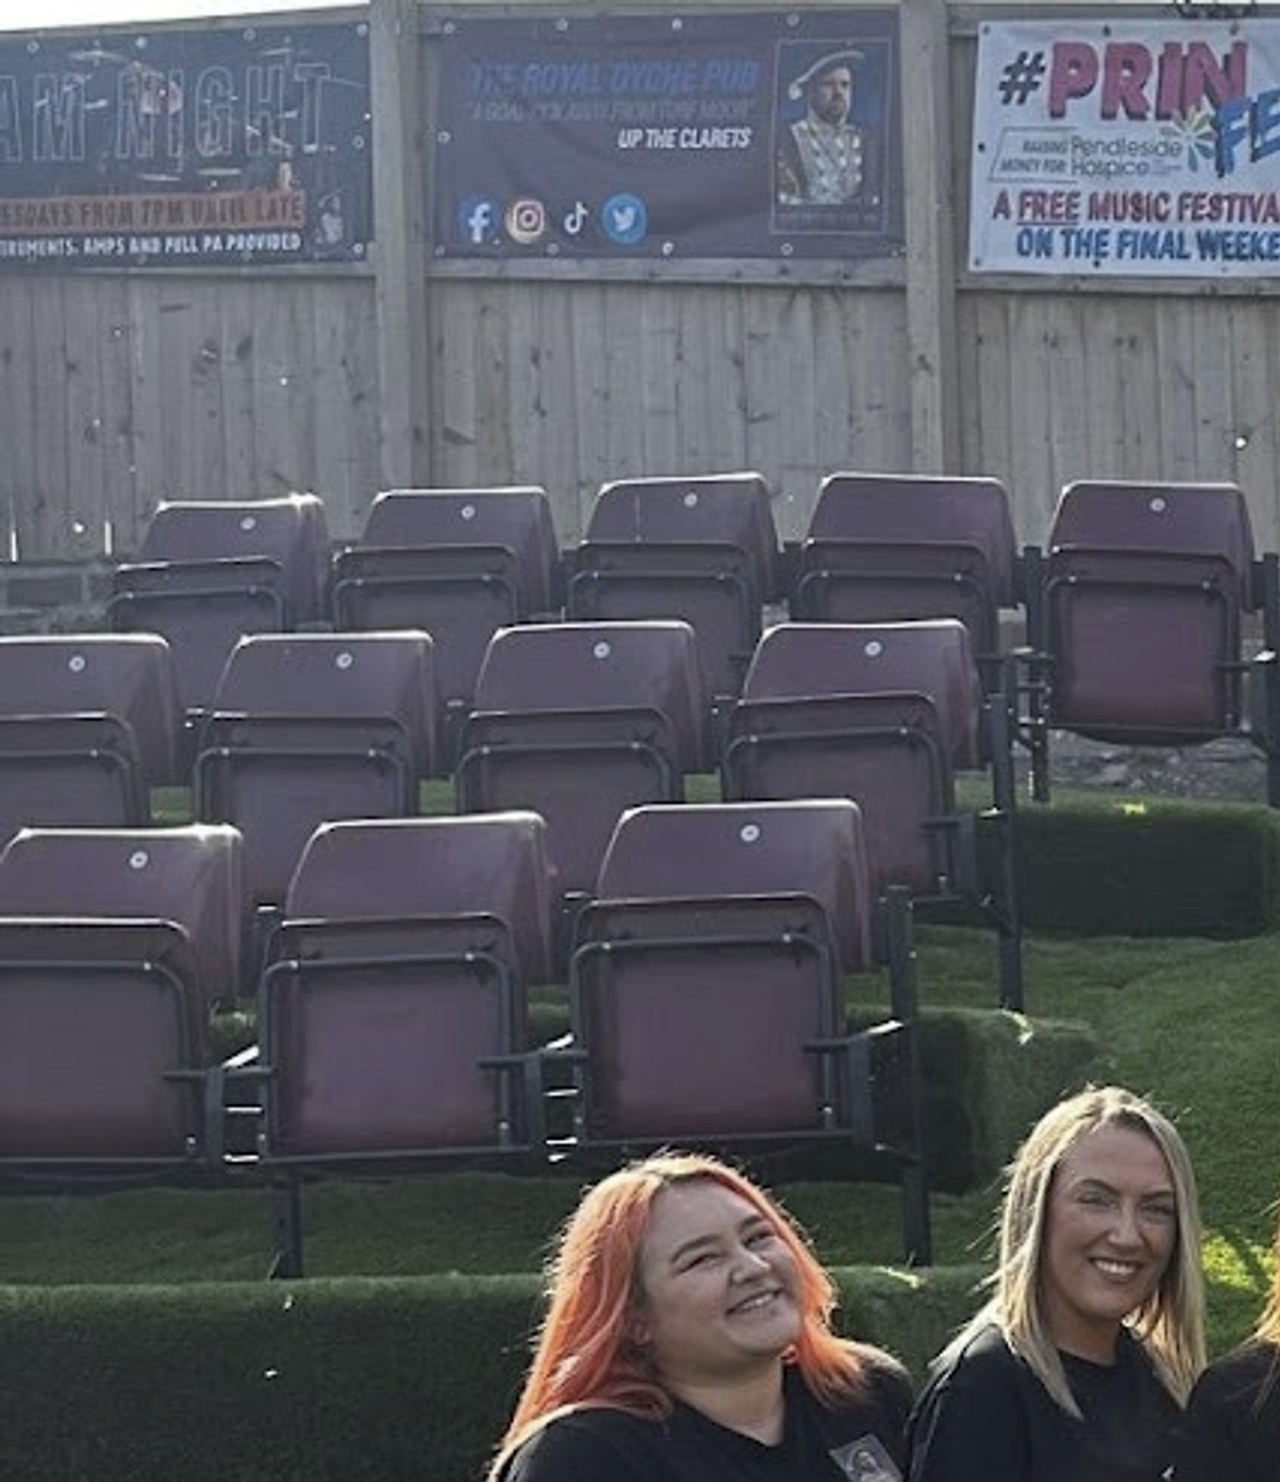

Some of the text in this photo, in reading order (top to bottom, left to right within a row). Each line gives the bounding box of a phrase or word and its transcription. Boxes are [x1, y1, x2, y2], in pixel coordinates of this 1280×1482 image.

[704, 62, 760, 93] PUB
[115, 63, 331, 158] NIGHT
[617, 128, 752, 148] UP THE CLARETS
[1070, 135, 1183, 158] Pendleside
[1070, 158, 1151, 181] Hospice
[80, 199, 134, 226] FROM
[255, 195, 302, 222] LATE
[992, 190, 1011, 221] A
[1017, 191, 1082, 225] FREE
[1086, 191, 1172, 224] MUSIC
[84, 236, 125, 256] AMPS
[129, 236, 161, 255] AND
[203, 234, 223, 253] PA
[225, 233, 301, 252] PROVIDED
[1016, 228, 1052, 258] ON
[1060, 228, 1111, 259] THE
[1116, 228, 1192, 261] FINAL
